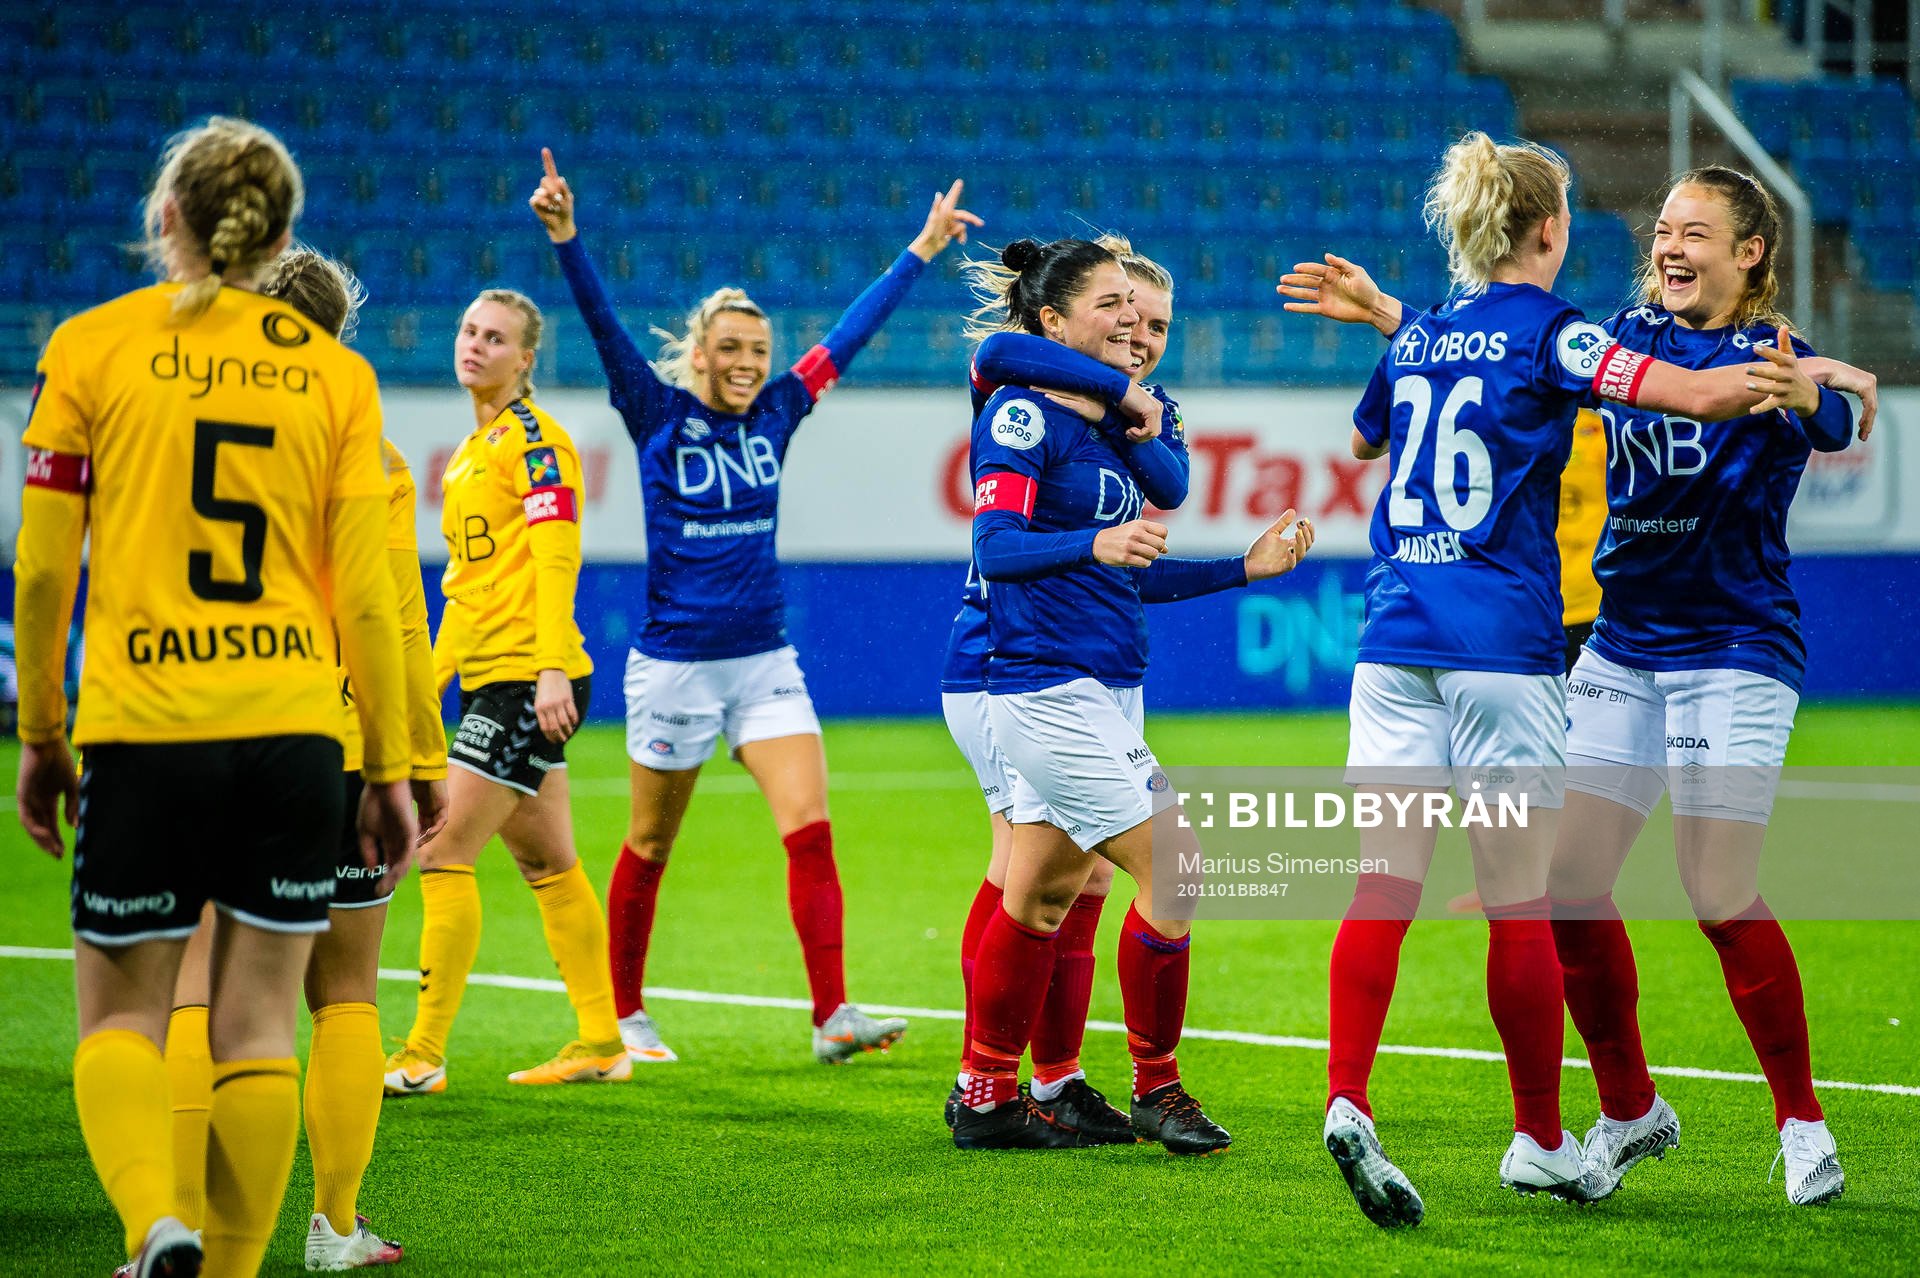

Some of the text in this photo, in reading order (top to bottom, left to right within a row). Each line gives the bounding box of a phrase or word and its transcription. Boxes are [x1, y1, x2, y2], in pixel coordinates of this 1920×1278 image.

[151, 334, 309, 399] dynea
[1431, 331, 1508, 363] OBOS
[997, 424, 1032, 442] OBOS
[1389, 374, 1493, 531] 26
[676, 422, 780, 510] DNB
[188, 419, 275, 602] 5
[1389, 531, 1469, 564] MADSEN
[128, 623, 323, 665] GAUSDAL
